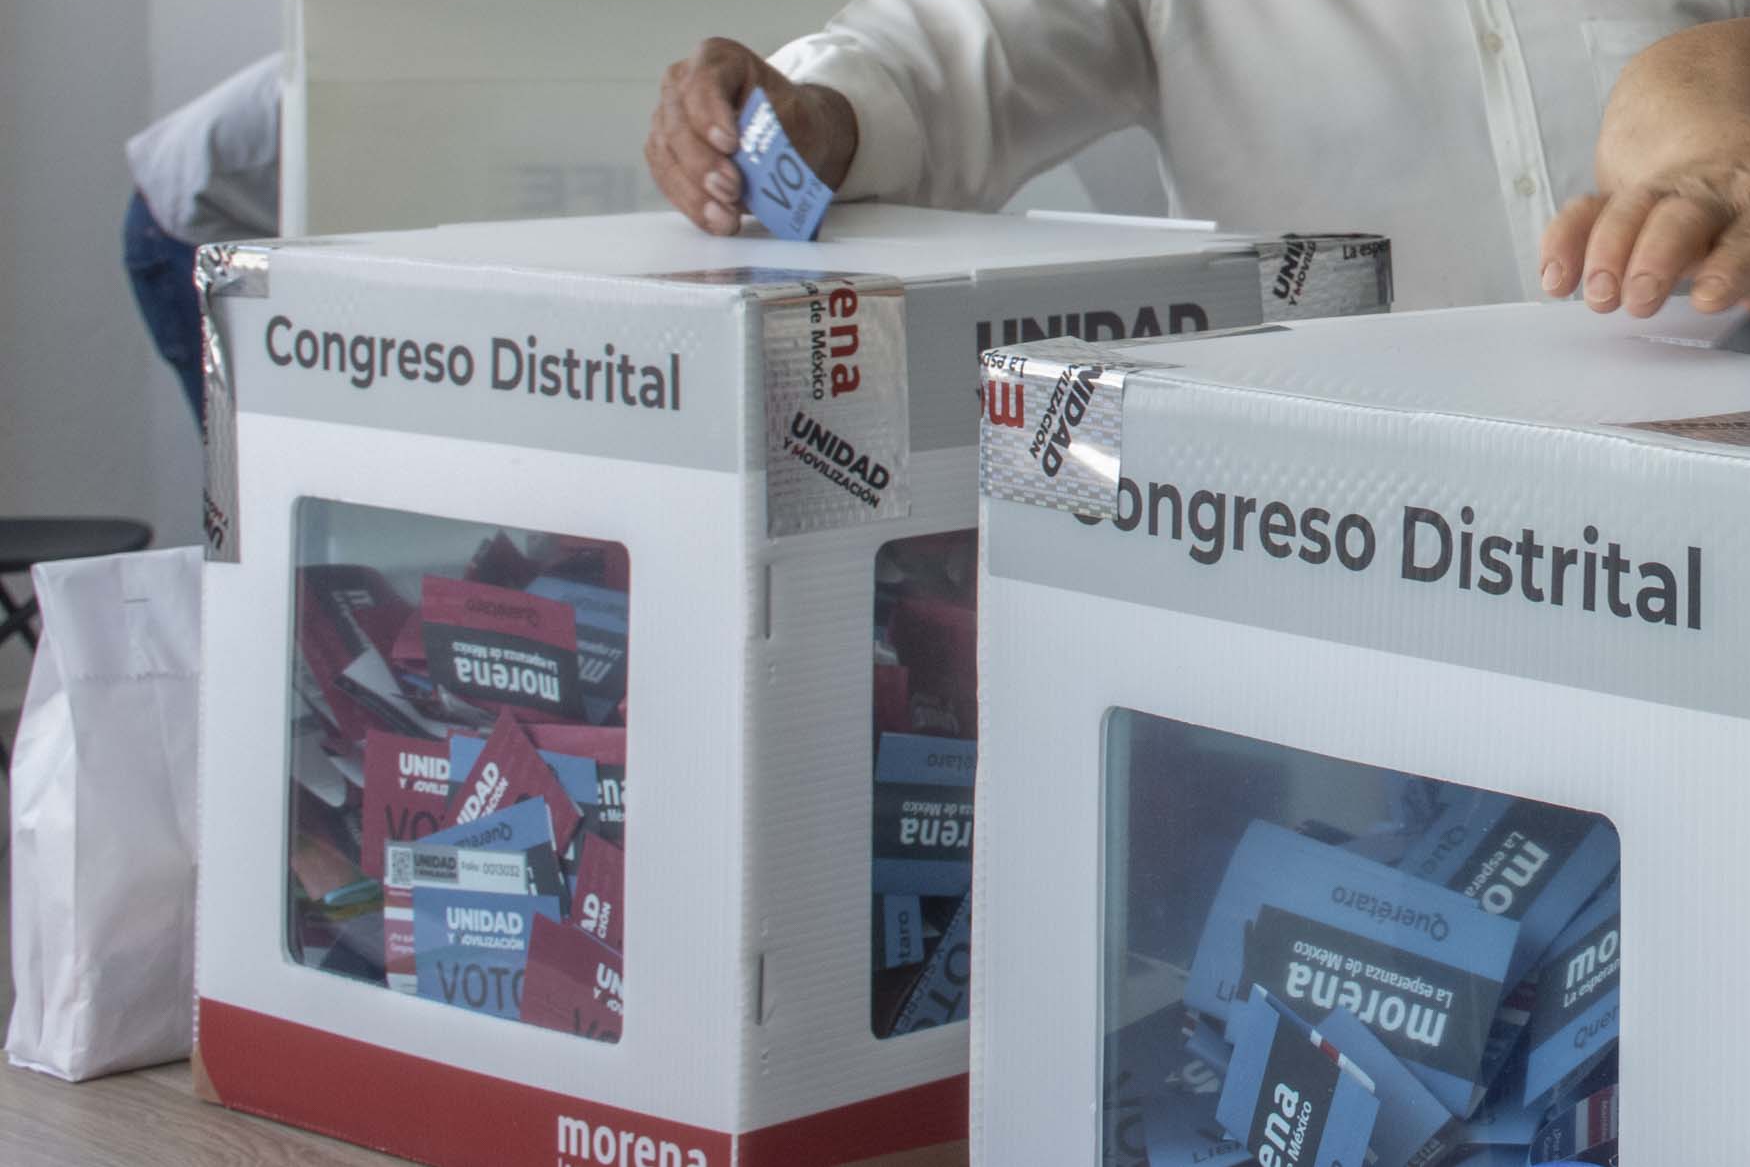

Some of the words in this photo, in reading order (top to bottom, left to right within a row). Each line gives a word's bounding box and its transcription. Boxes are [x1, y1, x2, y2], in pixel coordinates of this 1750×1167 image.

[265, 315, 474, 389] Congreso
[491, 335, 682, 411] Distrital
[811, 330, 828, 401] México
[783, 436, 793, 451] Y
[791, 444, 881, 508] MOVILIZACIÓN
[791, 411, 890, 490] UNIDAD
[1073, 476, 1377, 572] ongreso
[1401, 505, 1702, 631] Distrital
[453, 656, 560, 702] morena
[900, 817, 973, 848] rena
[446, 906, 523, 934] UNIDAD
[1331, 886, 1449, 942] Querétaro
[1293, 940, 1344, 971] México
[1345, 957, 1363, 977] de
[1366, 964, 1434, 998] esperanza
[1286, 962, 1447, 1047] morena
[1436, 987, 1454, 1009] La
[1287, 1101, 1312, 1162] México
